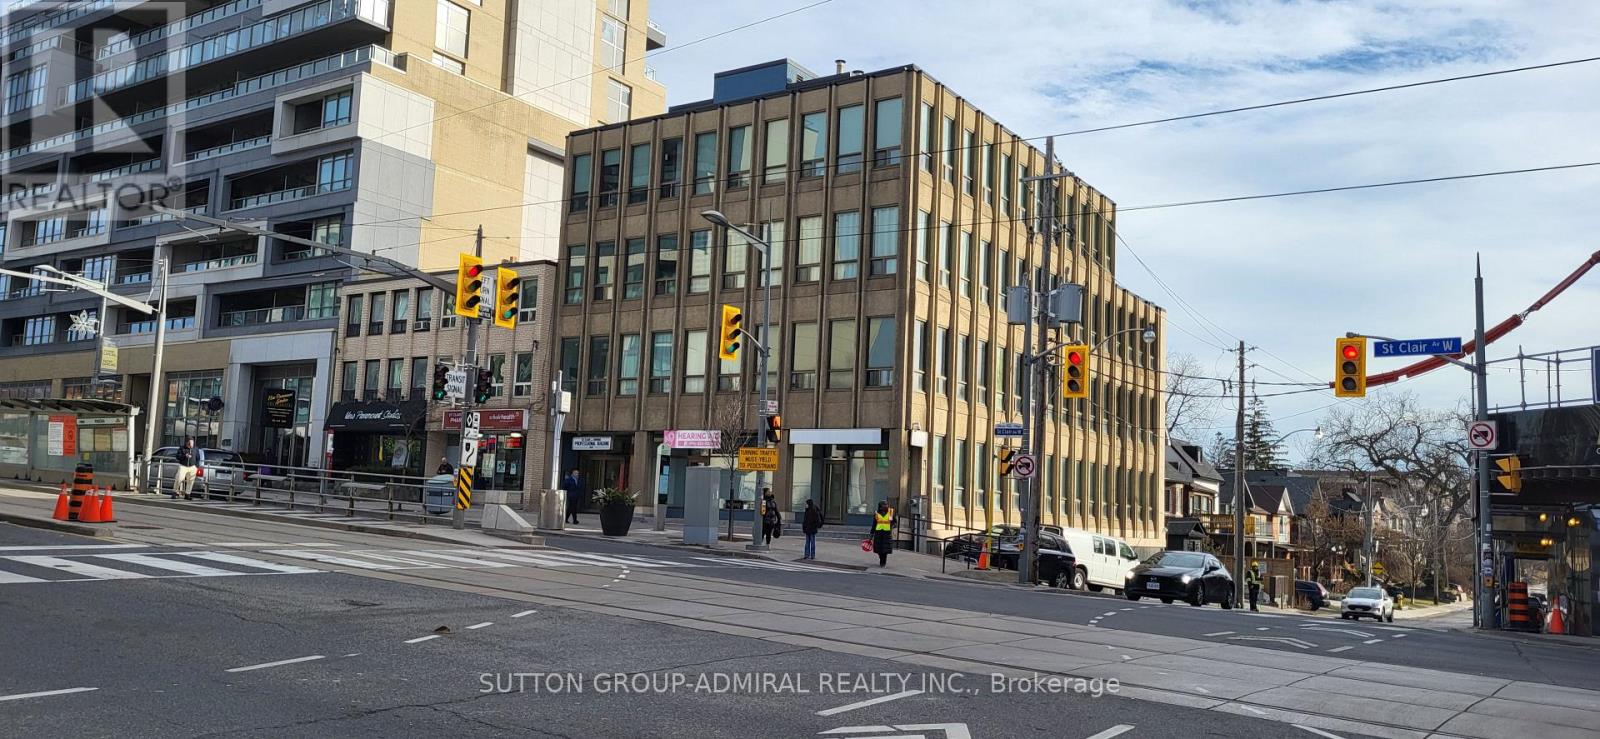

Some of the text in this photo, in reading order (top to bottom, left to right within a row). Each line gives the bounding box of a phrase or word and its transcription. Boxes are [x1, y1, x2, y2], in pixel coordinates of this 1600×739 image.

[1382, 343, 1394, 354] St
[1399, 341, 1428, 353] Clair
[1442, 340, 1454, 351] W
[447, 374, 465, 384] TRANSIT
[447, 384, 463, 394] SIGNAL
[678, 432, 707, 440] HEARING
